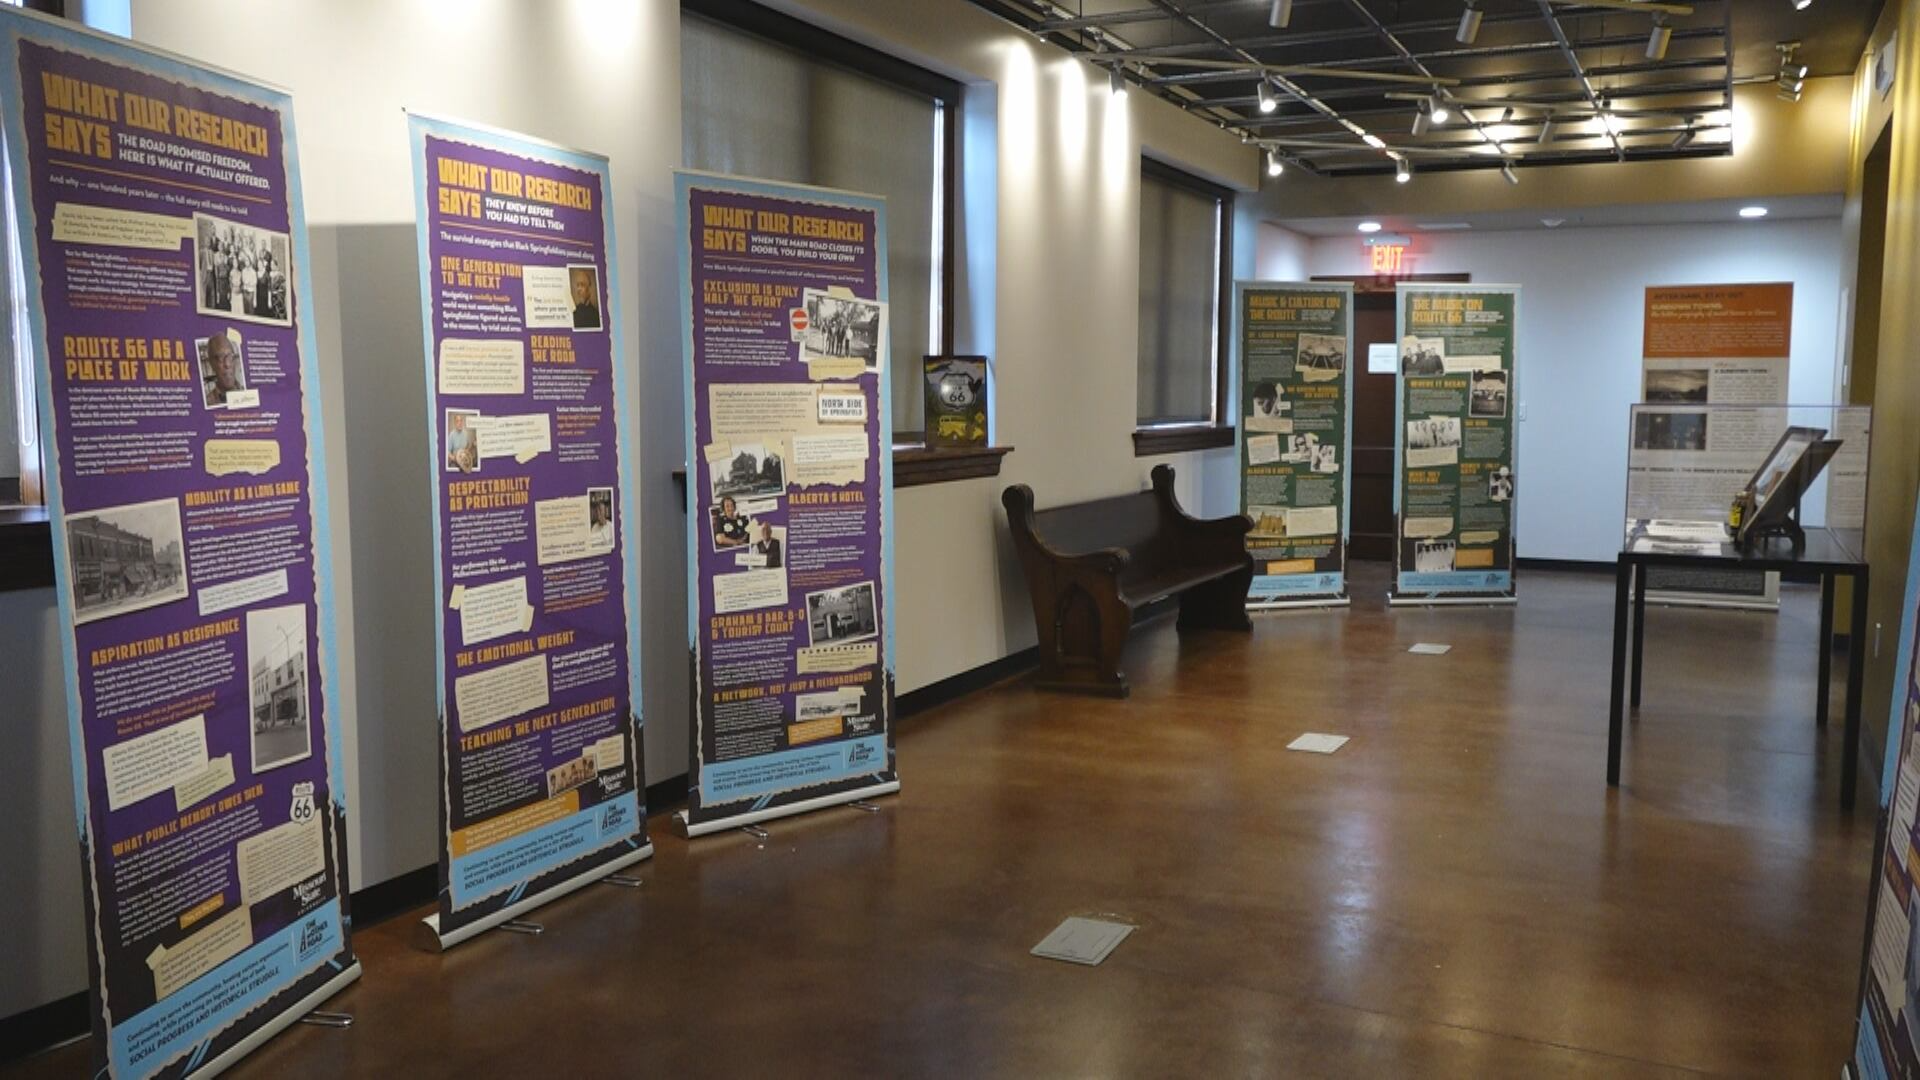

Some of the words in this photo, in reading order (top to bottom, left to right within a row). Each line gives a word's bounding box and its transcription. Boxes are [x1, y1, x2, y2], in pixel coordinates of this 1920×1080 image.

[42, 72, 119, 122] WHAT
[124, 93, 170, 134] OUR
[175, 105, 269, 157] RESEARCH
[45, 113, 112, 159] SAYS
[118, 133, 137, 148] THE
[140, 137, 165, 152] ROAD
[167, 144, 211, 162] PROMISED
[213, 155, 252, 172] FREEDOM.
[119, 150, 145, 164] HERE
[147, 155, 156, 165] IS
[157, 157, 182, 172] WHAT
[185, 163, 194, 173] IT
[195, 165, 234, 183] ACTUALLY
[50, 174, 63, 185] And
[65, 178, 79, 189] why
[88, 182, 99, 190] one
[101, 183, 127, 196] hundred
[128, 188, 144, 200] years
[145, 189, 159, 199] later
[166, 194, 174, 203] the
[175, 195, 185, 205] full
[186, 198, 200, 209] story
[437, 157, 487, 191] WHAT
[490, 168, 523, 198] OUR
[525, 175, 591, 211] RESEARCH
[438, 187, 481, 218] SAYS
[485, 198, 505, 209] THEY
[506, 201, 527, 213] KNEW
[528, 205, 554, 217] BEFORE
[486, 211, 502, 221] YOU
[504, 214, 519, 224] HAD
[520, 217, 529, 226] TO
[531, 218, 546, 228] TELL
[703, 205, 753, 229] WHAT
[757, 211, 789, 234] OUR
[793, 215, 864, 242] RESEARCH
[440, 231, 451, 240] The
[452, 234, 473, 244] survival
[475, 237, 502, 248] strategies
[503, 240, 514, 248] that
[515, 241, 529, 251] Black
[703, 229, 746, 252] SAYS
[751, 235, 774, 245] WHEN
[775, 236, 788, 246] THE
[789, 238, 808, 248] MAIN
[809, 240, 828, 250] ROAD
[829, 243, 853, 252] CLOSES
[854, 244, 864, 254] ITS
[751, 245, 779, 256] DOORS,
[781, 248, 796, 257] YOU
[797, 249, 817, 259] BUILD
[818, 251, 837, 261] YOUR
[838, 253, 855, 262] OWN
[1373, 246, 1404, 272] EXIT
[441, 256, 460, 270] ONE
[463, 259, 522, 278] GENERATION
[441, 271, 454, 285] TO
[457, 272, 472, 287] THE
[475, 274, 501, 289] NEXT
[704, 280, 760, 294] EXCLUSION
[763, 284, 772, 295] IS
[775, 285, 799, 298] ONLY
[704, 292, 729, 305] HALF
[733, 294, 749, 306] THE
[752, 295, 782, 308] STORY
[1412, 311, 1446, 323] ROUTE
[1447, 311, 1462, 324] 66
[64, 335, 120, 359] ROUTE
[125, 338, 147, 359] 66
[152, 339, 170, 359] AS
[175, 340, 185, 360] A
[531, 335, 572, 350] READING
[531, 350, 549, 363] THE
[550, 350, 576, 363] ROOM
[66, 359, 113, 381] PLACE
[118, 360, 140, 381] OF
[144, 360, 192, 381] WORK
[822, 399, 844, 408] NORTH
[846, 399, 862, 408] SIDE
[950, 393, 966, 402] 66
[185, 489, 230, 506] MOBILITY
[234, 486, 245, 500] AS
[247, 486, 254, 499] A
[254, 484, 274, 499] LONG
[275, 481, 300, 497] GAME
[449, 477, 530, 497] RESPECTABILITY
[839, 491, 864, 502] HOTEL
[450, 497, 463, 512] AS
[466, 491, 528, 510] PROTECTION
[723, 624, 762, 638] TOURIST
[765, 621, 795, 634] COURT
[91, 637, 164, 667] ASPIRATION
[167, 632, 180, 649] AS
[182, 617, 240, 644] RESISTANCE
[456, 653, 474, 668] THE
[477, 639, 535, 663] EMOTIONAL
[537, 630, 575, 650] WEIGHT
[713, 693, 719, 702] A
[770, 685, 785, 695] NOT
[788, 682, 807, 692] JUST
[809, 680, 814, 688] A
[816, 672, 872, 687] NEIGHBORHOOD
[460, 725, 512, 752] TEACHING
[515, 720, 530, 735] THE
[532, 712, 558, 731] NEXT
[560, 697, 615, 723] GENERATION
[294, 798, 311, 818] 66
[112, 835, 143, 857] WHAT
[146, 823, 178, 844] PUBLIC
[180, 806, 217, 829] MEMORY
[218, 794, 243, 815] OWES
[244, 783, 264, 804] THEM
[126, 1020, 159, 1043] Continuing
[168, 1008, 181, 1020] serve
[182, 1002, 192, 1011] the
[129, 1046, 155, 1066] SOCIAL
[157, 1021, 194, 1048] PROGRESS
[195, 1011, 210, 1025] AND
[211, 989, 247, 1014] HISTORICAL
[249, 967, 281, 991] STRUGGLE
